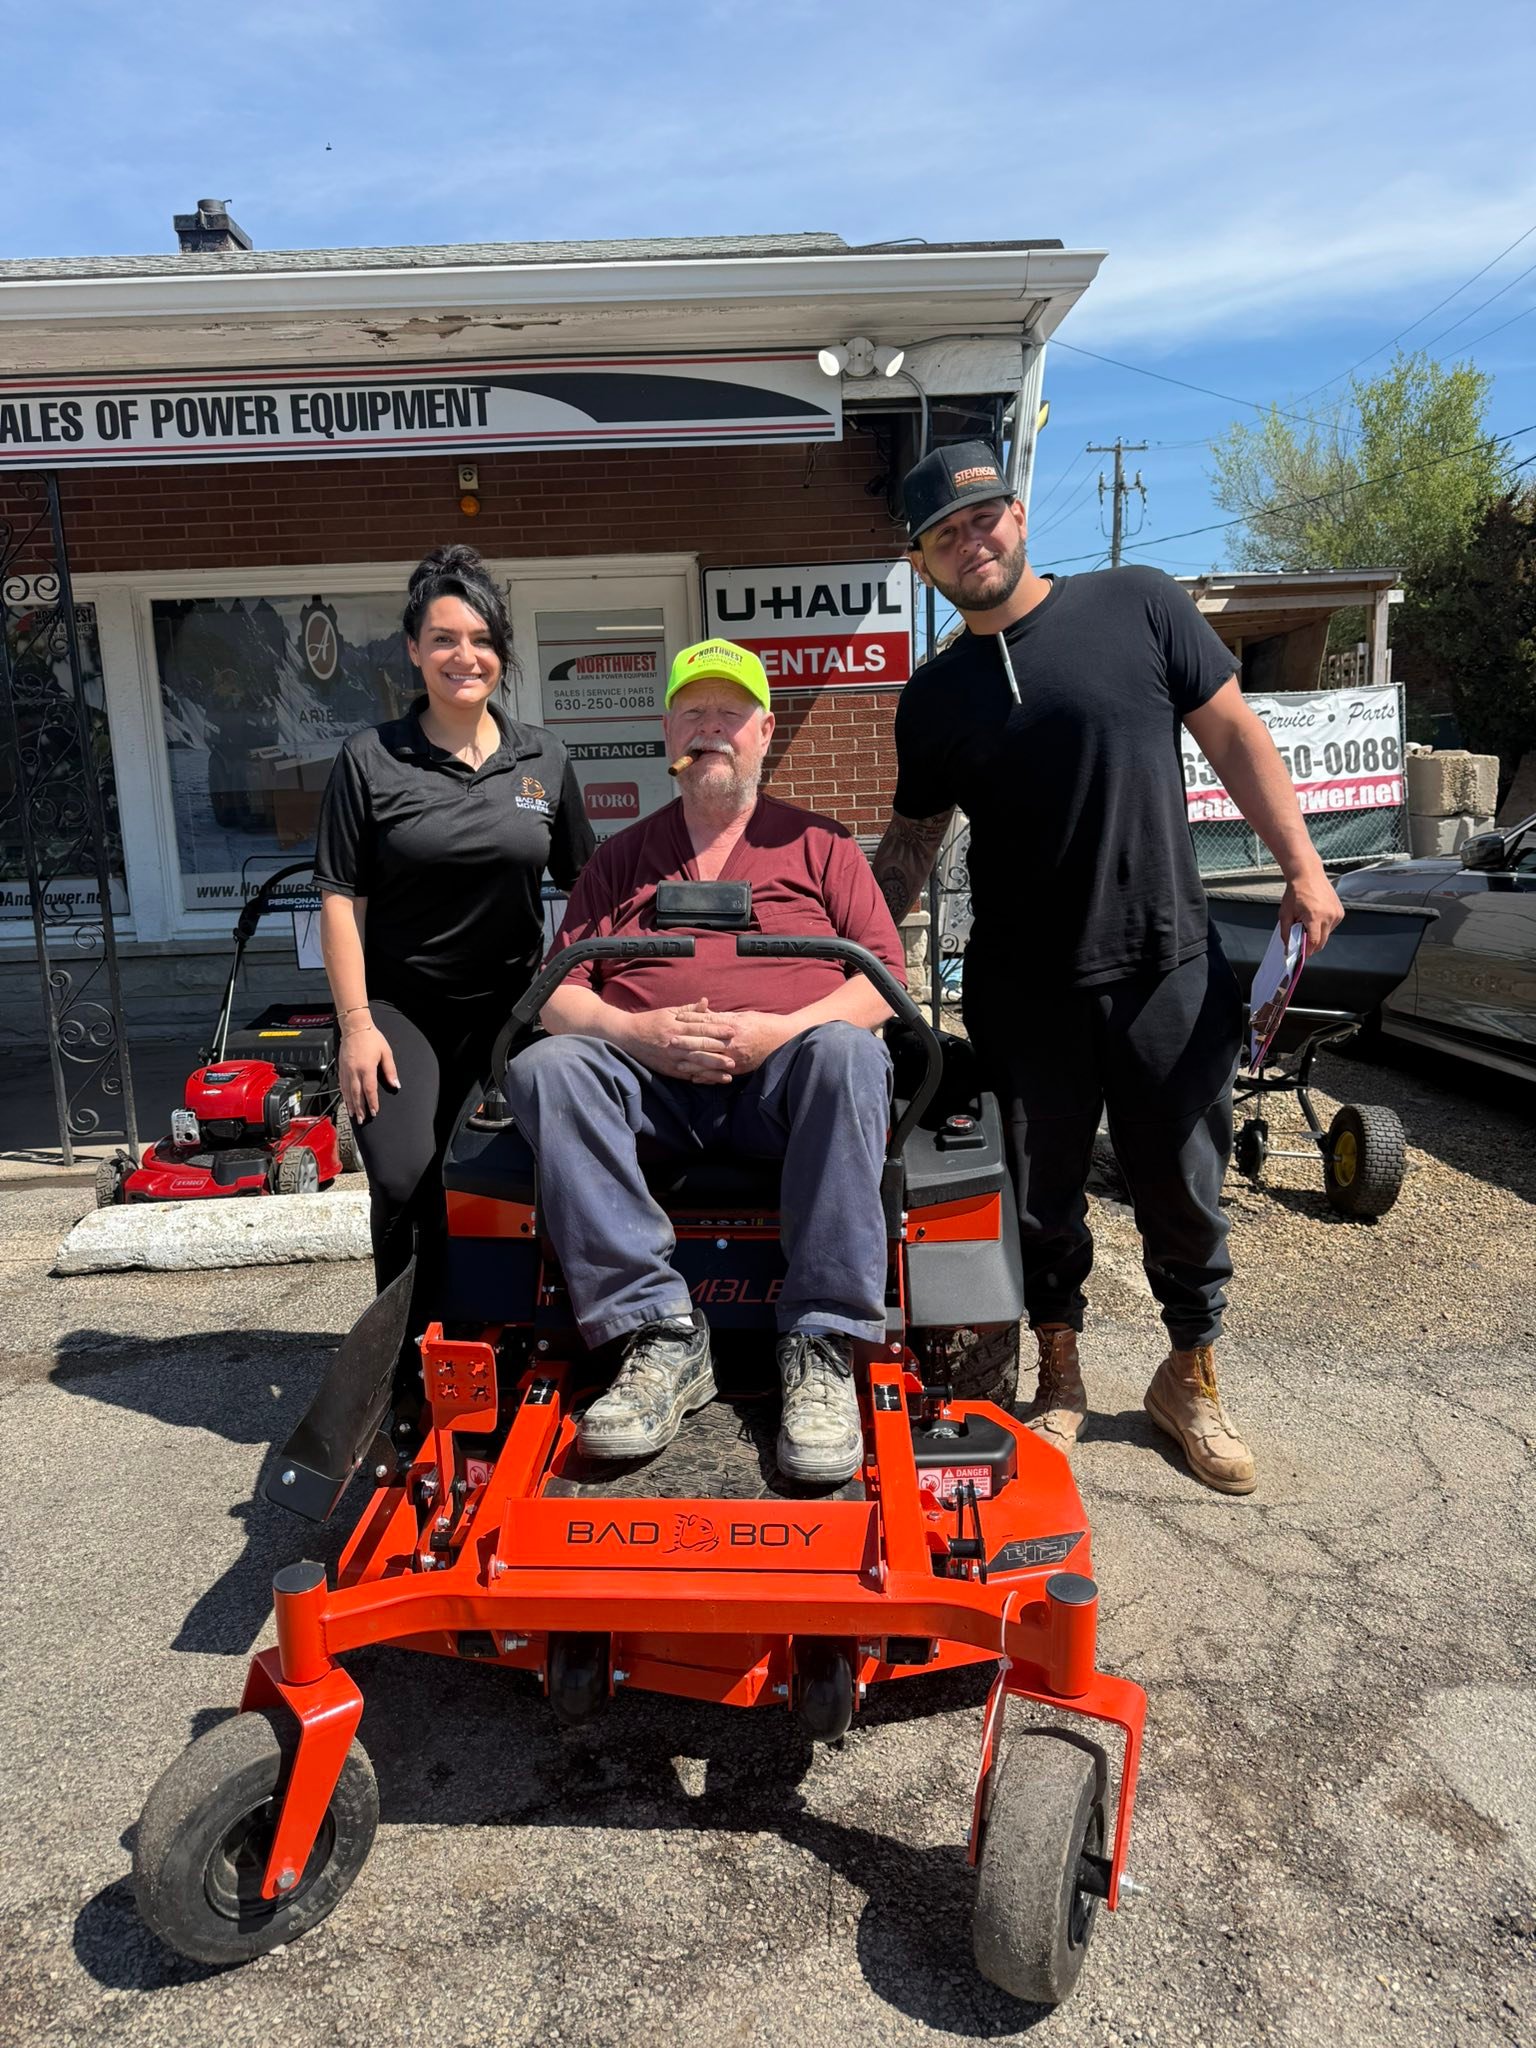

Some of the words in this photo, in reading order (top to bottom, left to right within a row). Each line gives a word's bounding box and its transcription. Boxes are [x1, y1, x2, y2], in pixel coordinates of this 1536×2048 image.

[95, 399, 139, 441] OF
[150, 396, 280, 439] POWER
[290, 387, 491, 439] EQUIPMENT
[716, 582, 902, 622] U-HAUL
[698, 646, 743, 663] NORTHWEST
[761, 644, 886, 676] ENTALS
[576, 655, 657, 674] NORTHWEST
[577, 673, 594, 681] LAWN
[602, 673, 623, 681] POWER
[624, 671, 658, 680] EQUIPMENT
[554, 689, 581, 698] SALES
[586, 688, 621, 697] SERVICE
[628, 686, 655, 695] PARTS
[554, 696, 655, 711] 630-250-0088
[1348, 702, 1396, 726] Parts
[568, 744, 656, 758] ENTRANCE
[514, 796, 534, 804] BAD
[535, 798, 550, 808] BOY
[516, 802, 549, 814] MOWERS
[587, 793, 636, 809] TORO
[267, 897, 323, 907] PERSONAL
[621, 941, 681, 956] BAD
[750, 941, 810, 956] BOY
[956, 1467, 989, 1478] DANGER
[567, 1521, 659, 1545] BAD
[730, 1523, 823, 1546] BOY
